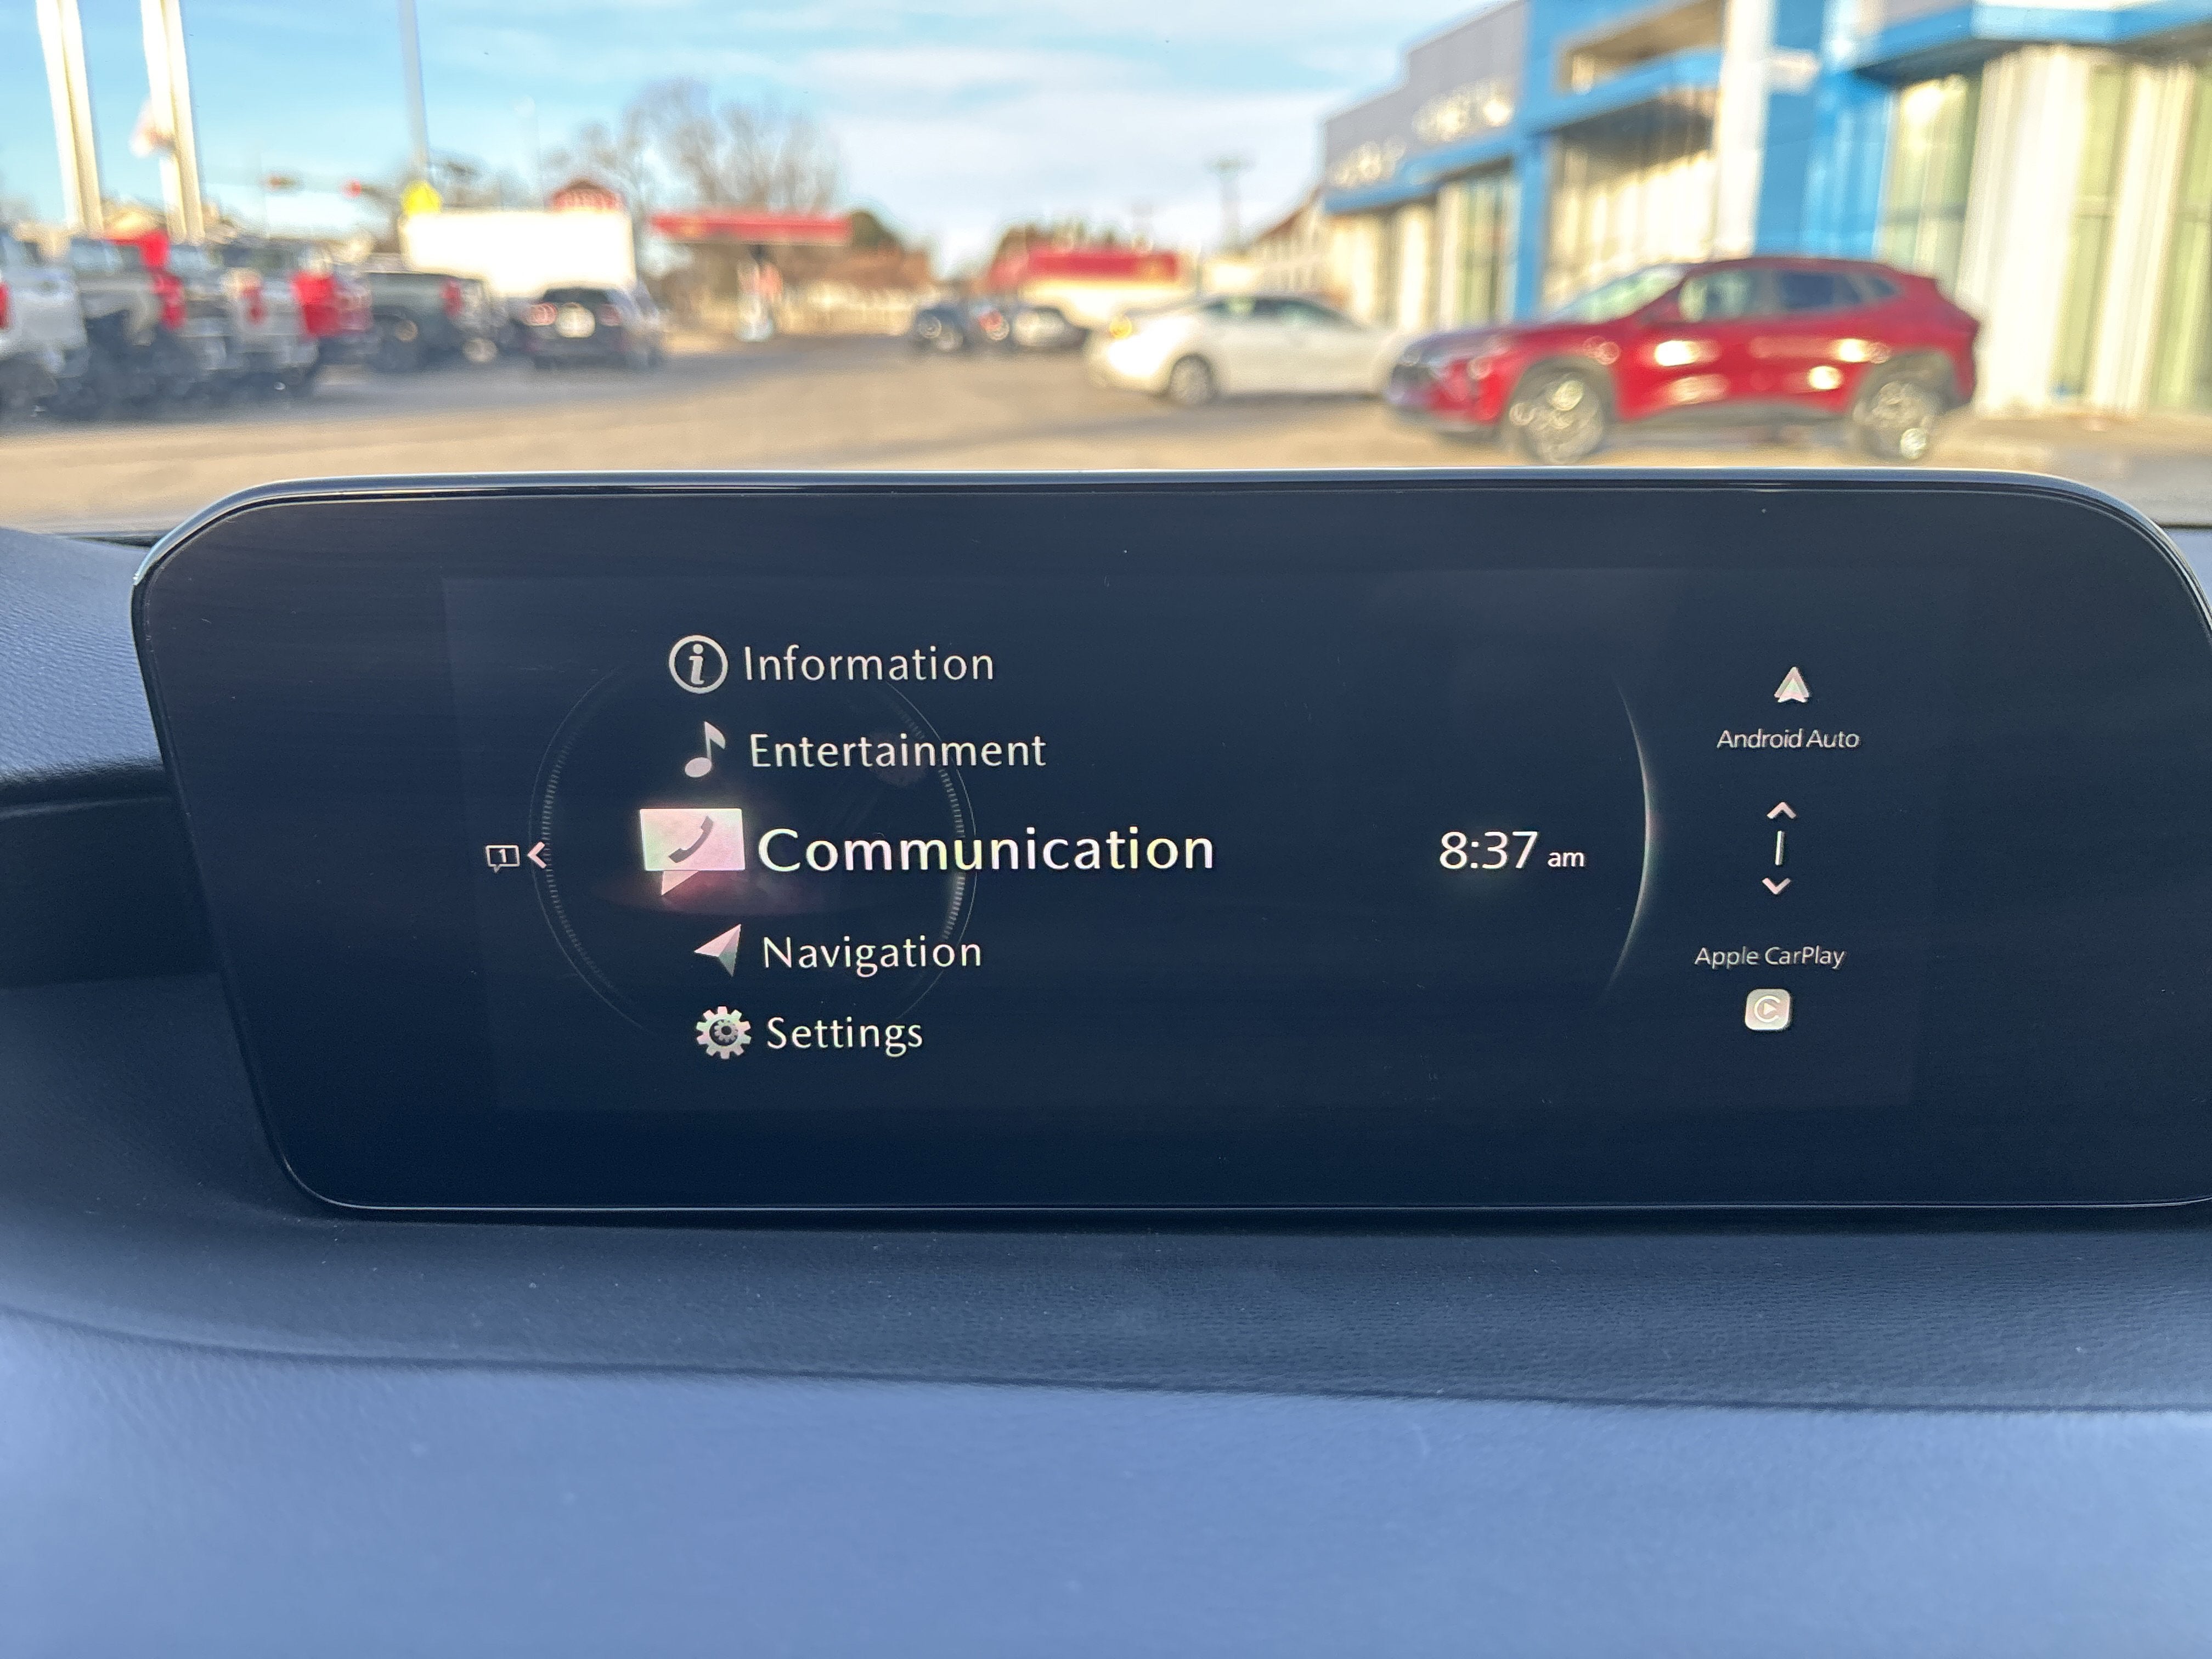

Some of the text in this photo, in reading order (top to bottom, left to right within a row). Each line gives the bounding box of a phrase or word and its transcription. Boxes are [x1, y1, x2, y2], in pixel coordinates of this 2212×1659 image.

[744, 644, 994, 681] Information
[751, 733, 1047, 768] Entertainment
[1716, 727, 1860, 749] Android Auto
[758, 826, 1213, 872] Communication
[1439, 831, 1585, 870] 8:37 am
[764, 935, 981, 978] Navigation
[1694, 945, 1846, 970] Apple CarPlay
[767, 1016, 923, 1057] Settings
